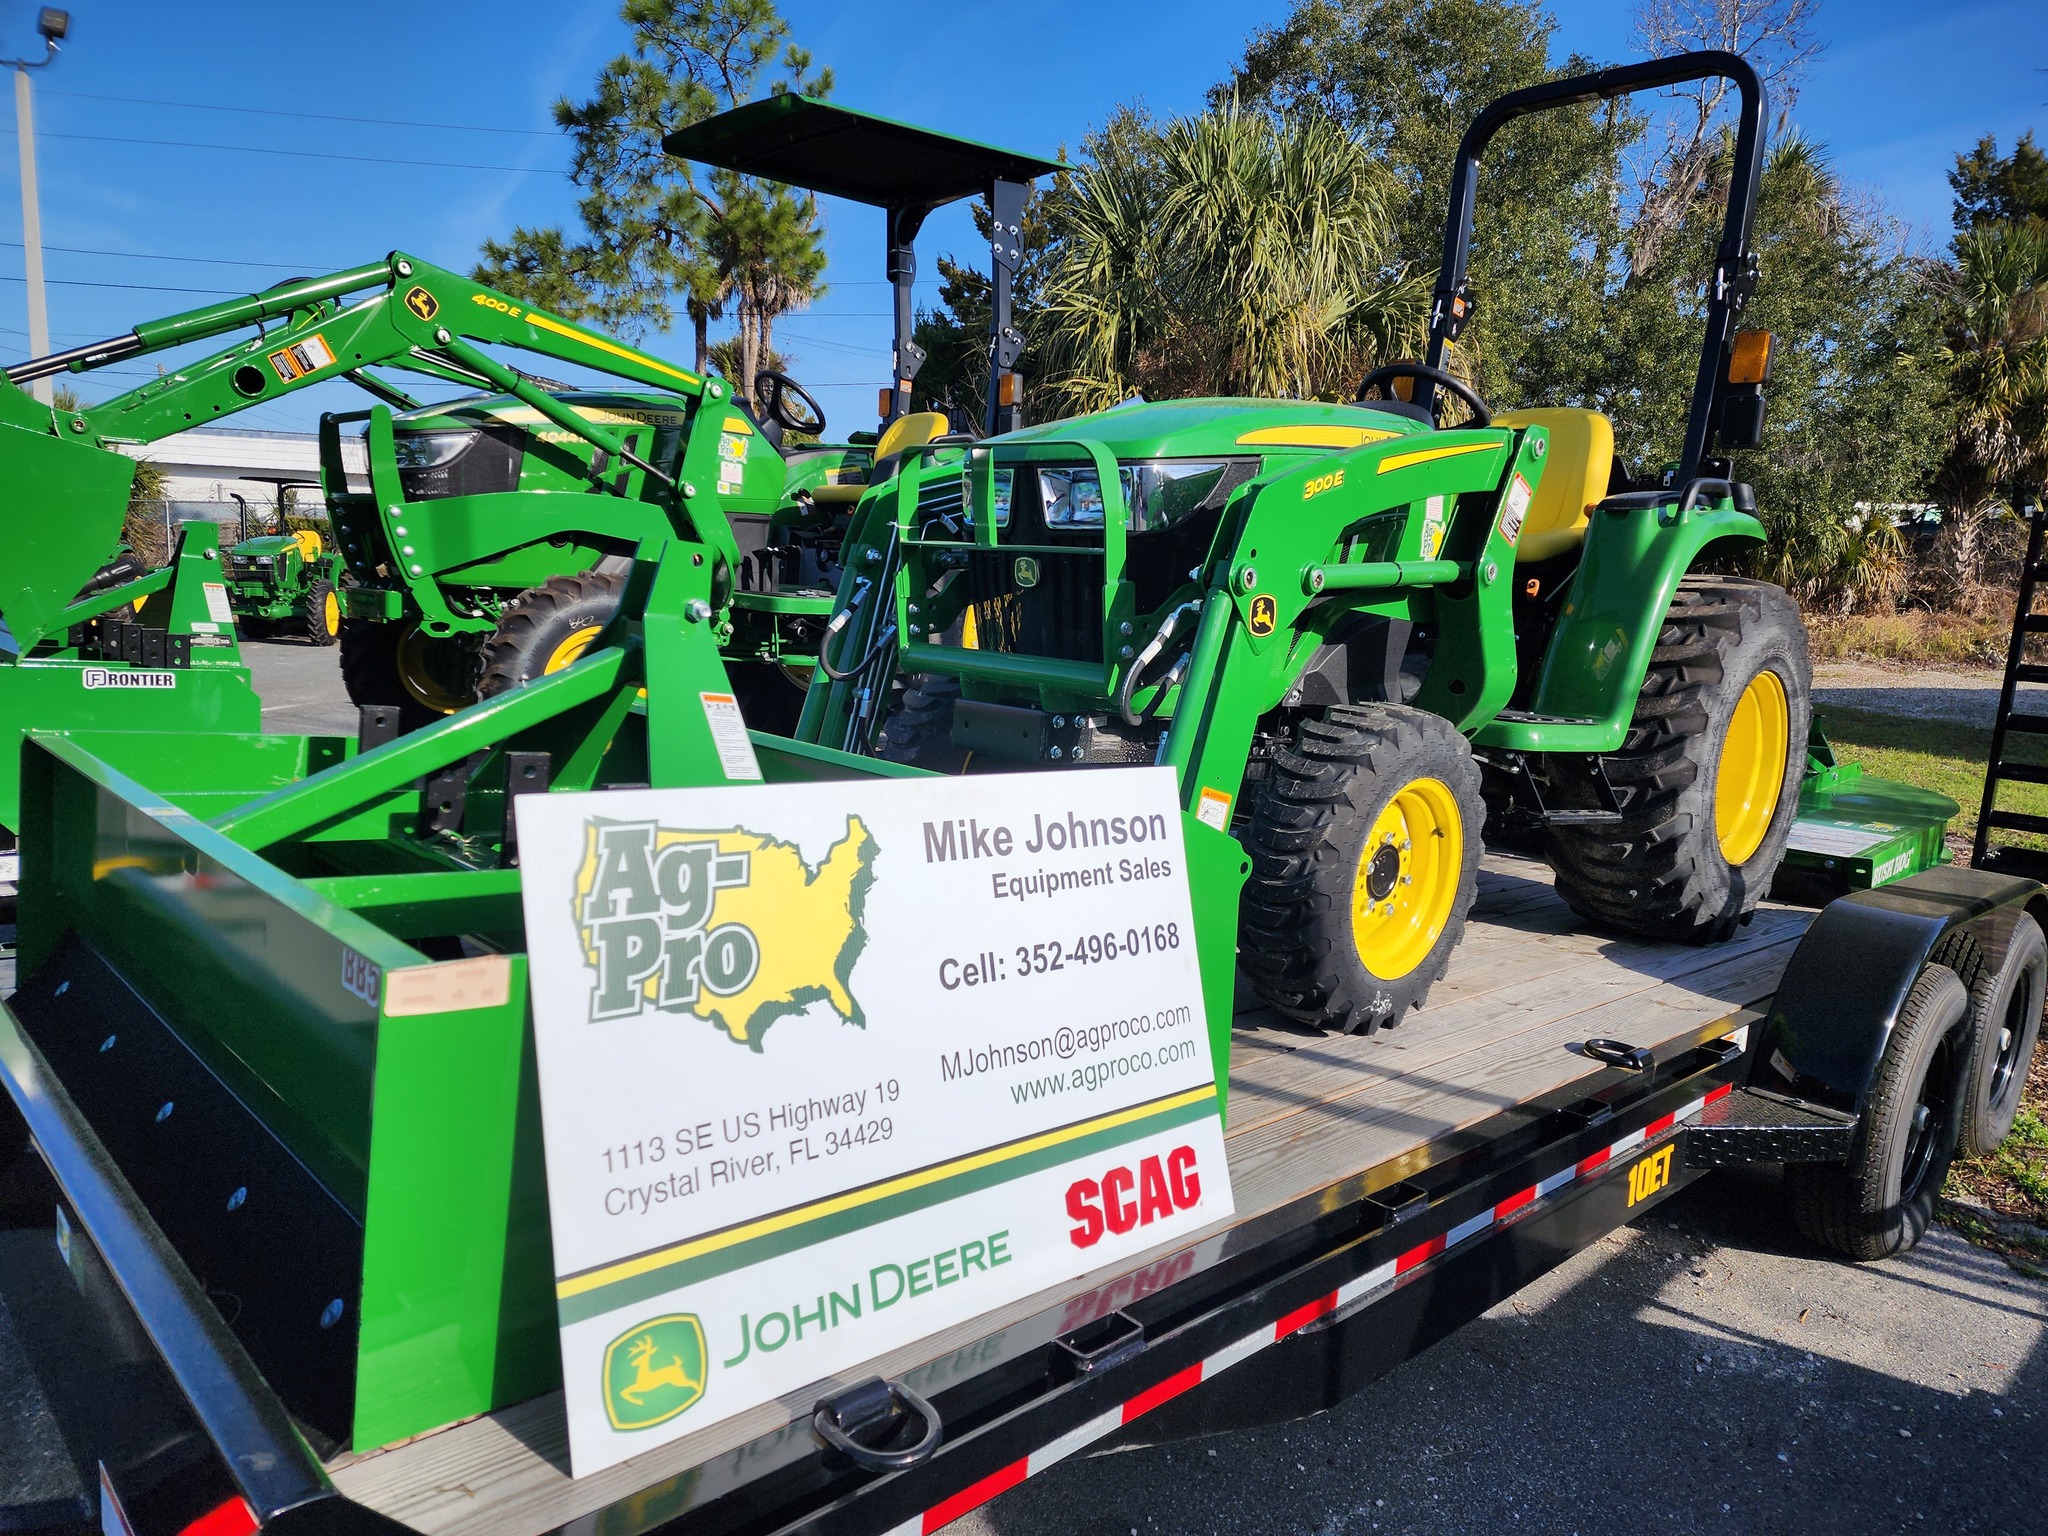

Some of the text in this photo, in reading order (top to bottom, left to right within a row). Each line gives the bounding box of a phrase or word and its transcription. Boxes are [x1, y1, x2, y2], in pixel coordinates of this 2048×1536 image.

[471, 293, 522, 318] 400E
[600, 410, 677, 425] JOHN DEERE
[1304, 469, 1345, 499] 300E
[86, 670, 173, 687] FRONTIER
[923, 811, 1167, 864] Mike Johnson
[584, 821, 749, 931] Ag-
[992, 857, 1172, 901] Equipment Sales
[1872, 858, 1895, 888] BUSH
[590, 917, 759, 1022] Pro
[939, 922, 1180, 990] Cell: 352-496-0168
[940, 1005, 1192, 1082] MJohnson@agproco.com
[1010, 1040, 1196, 1104] www.agproco.com
[602, 1079, 900, 1173] 1113 SE US Highway 19
[604, 1117, 893, 1216] Crystal River, FL 34429
[1065, 1145, 1202, 1250] SCAG
[1627, 1144, 1675, 1208] 10ET
[723, 1229, 1012, 1369] JOHN DEERE
